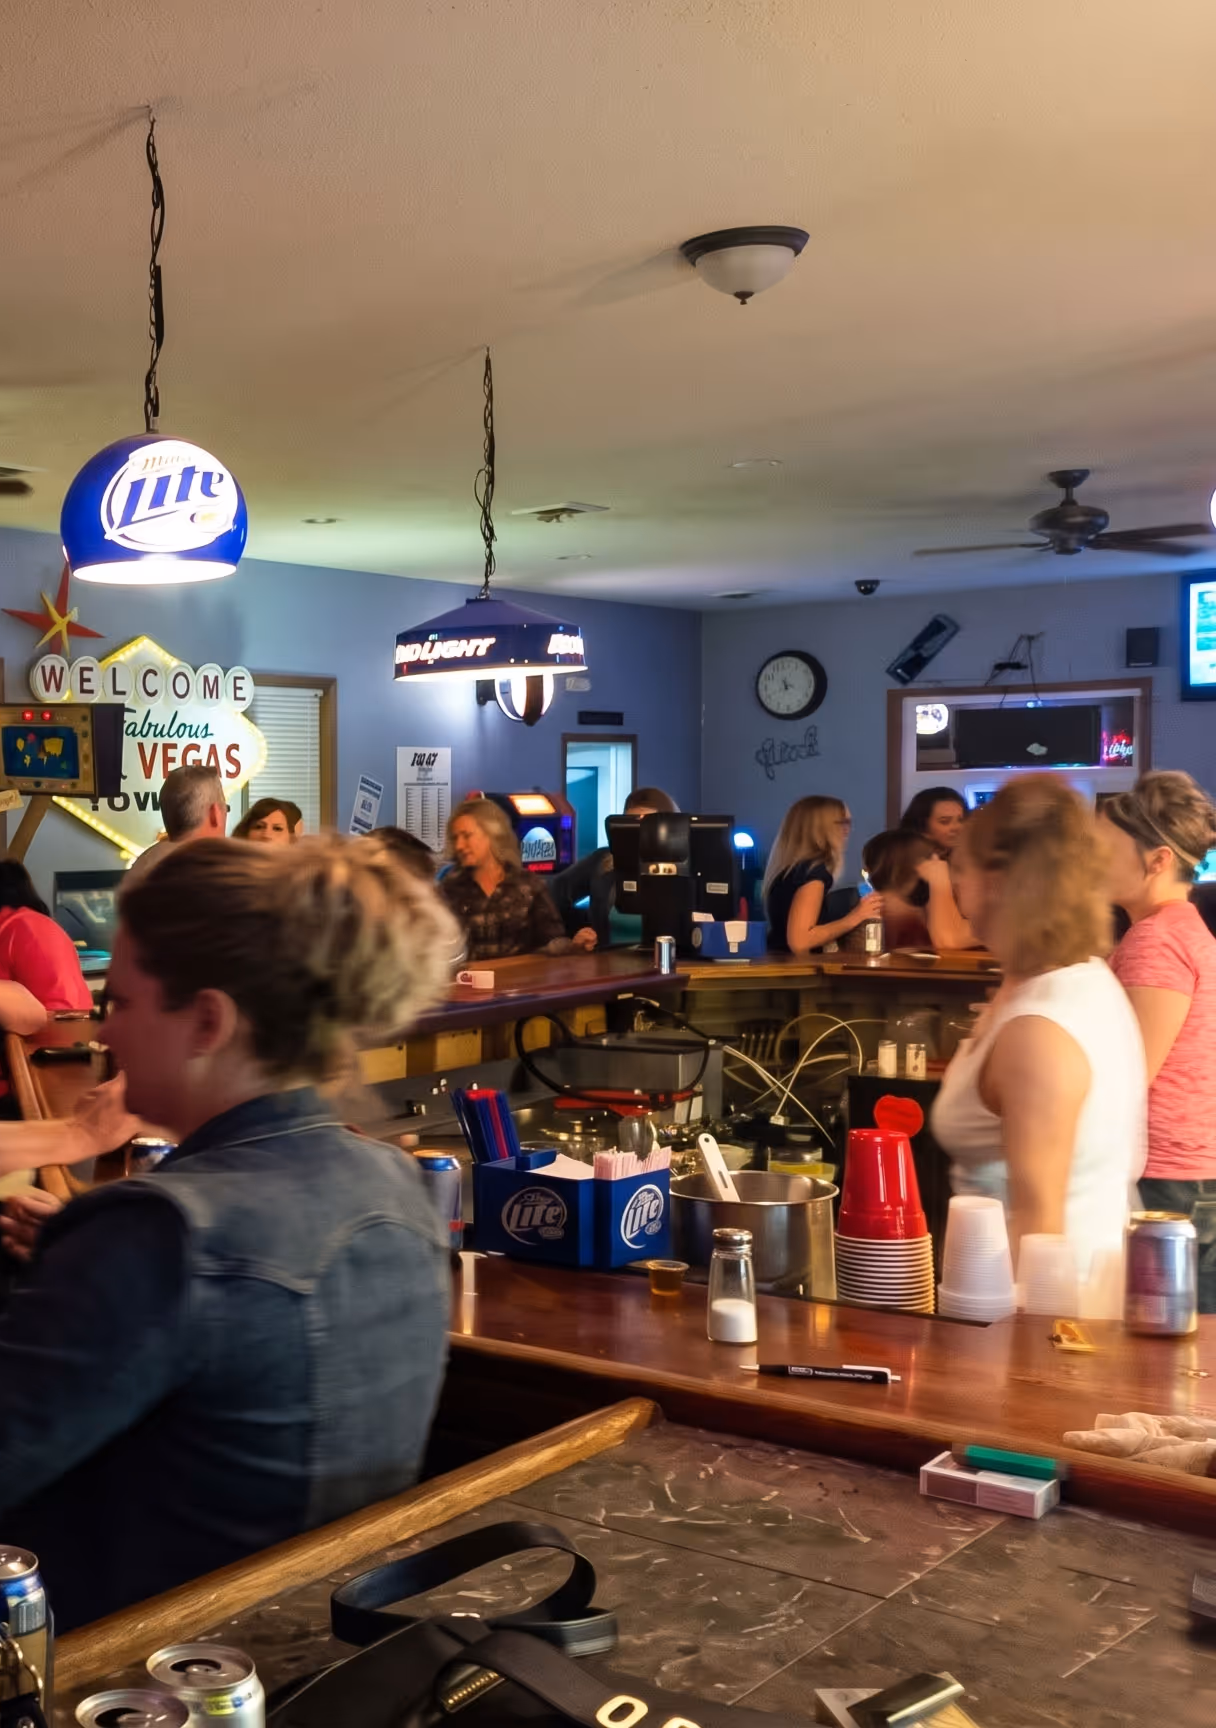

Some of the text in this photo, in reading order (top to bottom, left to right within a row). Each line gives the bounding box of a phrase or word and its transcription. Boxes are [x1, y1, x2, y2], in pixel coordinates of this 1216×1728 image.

[117, 465, 224, 530] Lite
[40, 664, 247, 701] WELCOME
[124, 707, 214, 739] abulous
[509, 1203, 560, 1232] Lite
[626, 1199, 659, 1240] Lite
